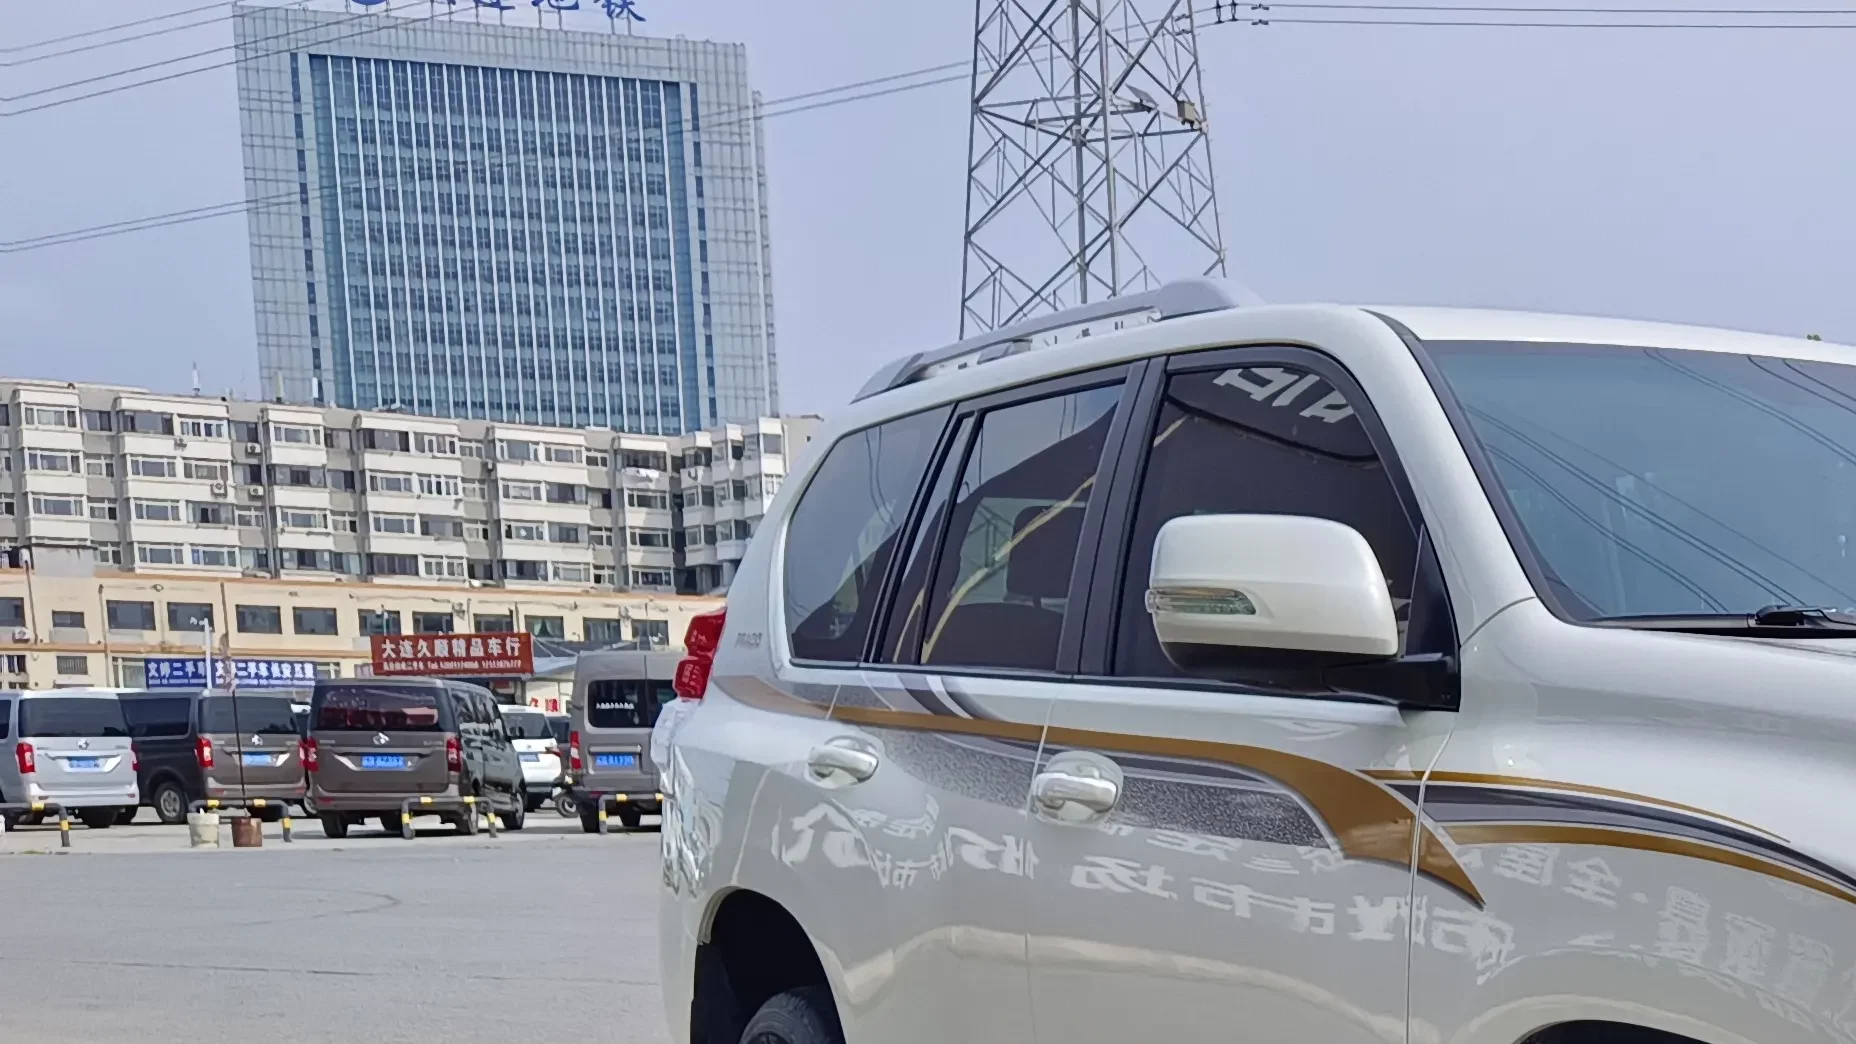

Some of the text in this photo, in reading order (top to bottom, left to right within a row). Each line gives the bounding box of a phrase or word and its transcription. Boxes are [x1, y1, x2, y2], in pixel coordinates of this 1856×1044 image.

[381, 636, 521, 659] 大连久顺精品车行
